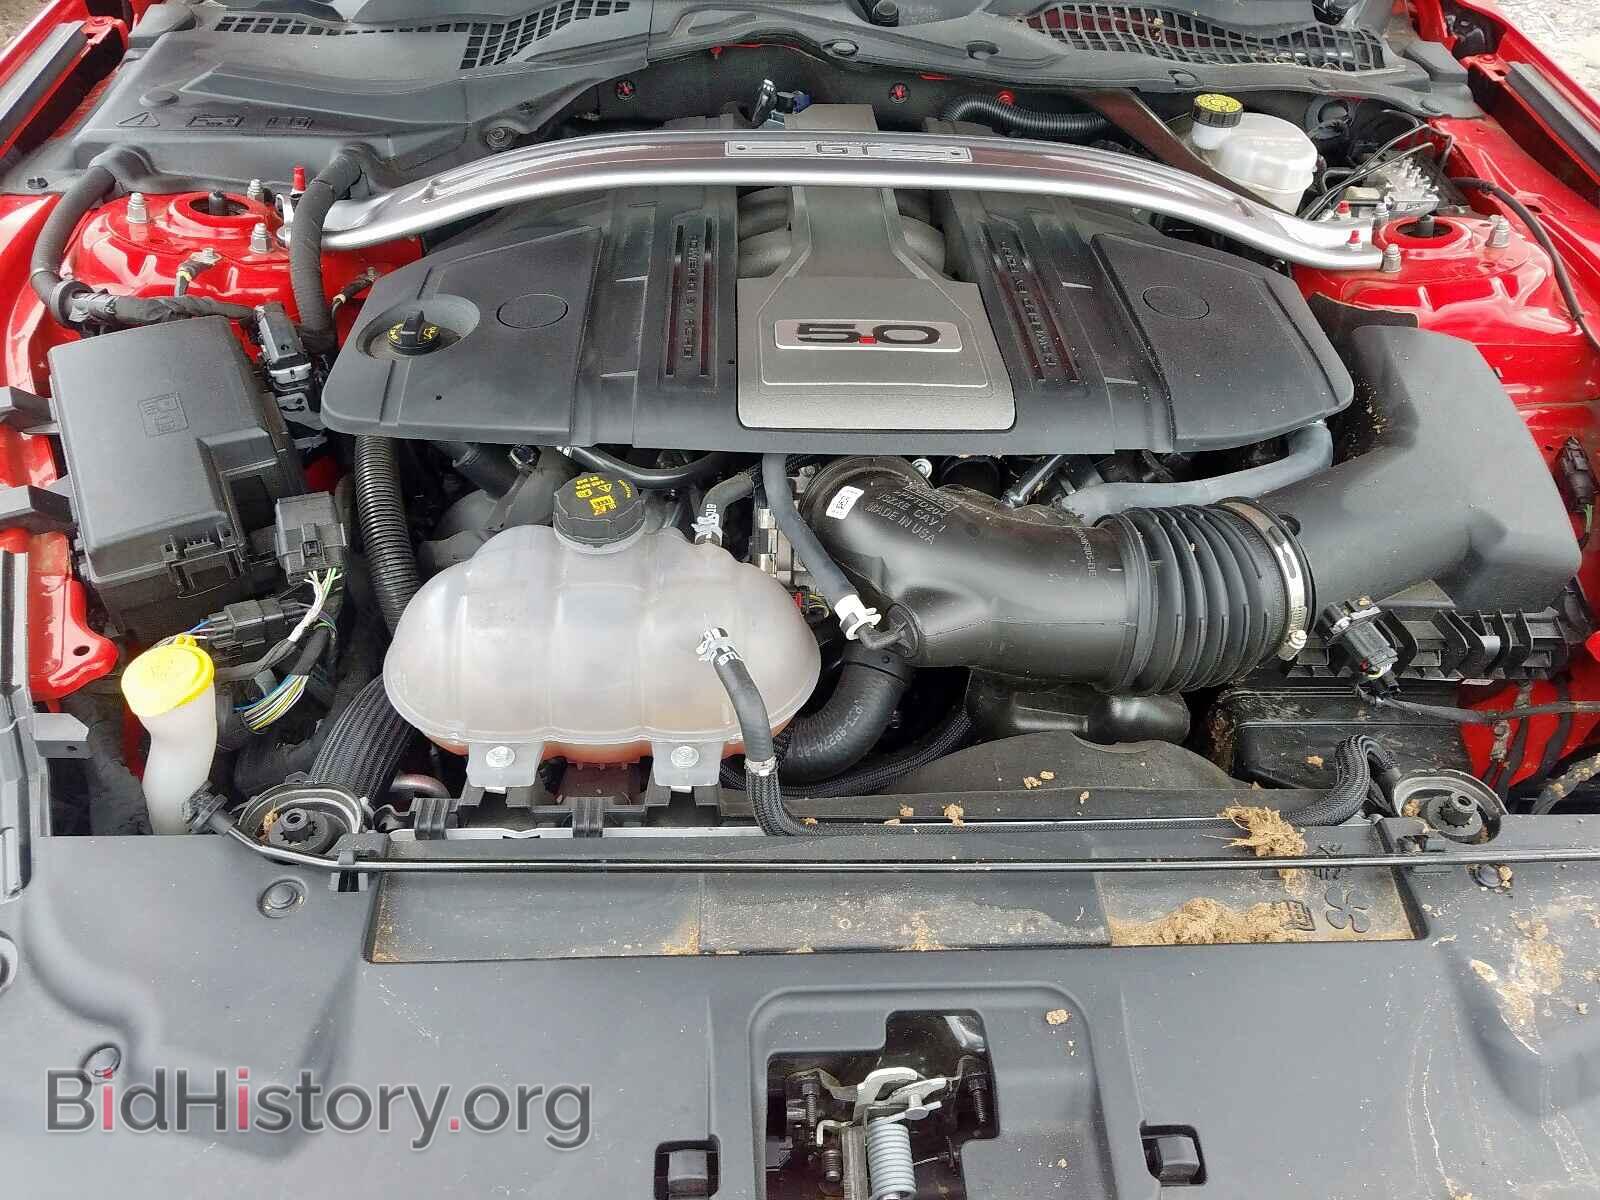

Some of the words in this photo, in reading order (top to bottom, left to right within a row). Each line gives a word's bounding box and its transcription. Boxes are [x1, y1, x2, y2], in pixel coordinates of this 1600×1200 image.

[797, 323, 941, 345] 5.0
[864, 502, 898, 522] MADE
[898, 515, 912, 530] IN
[911, 523, 937, 546] USA
